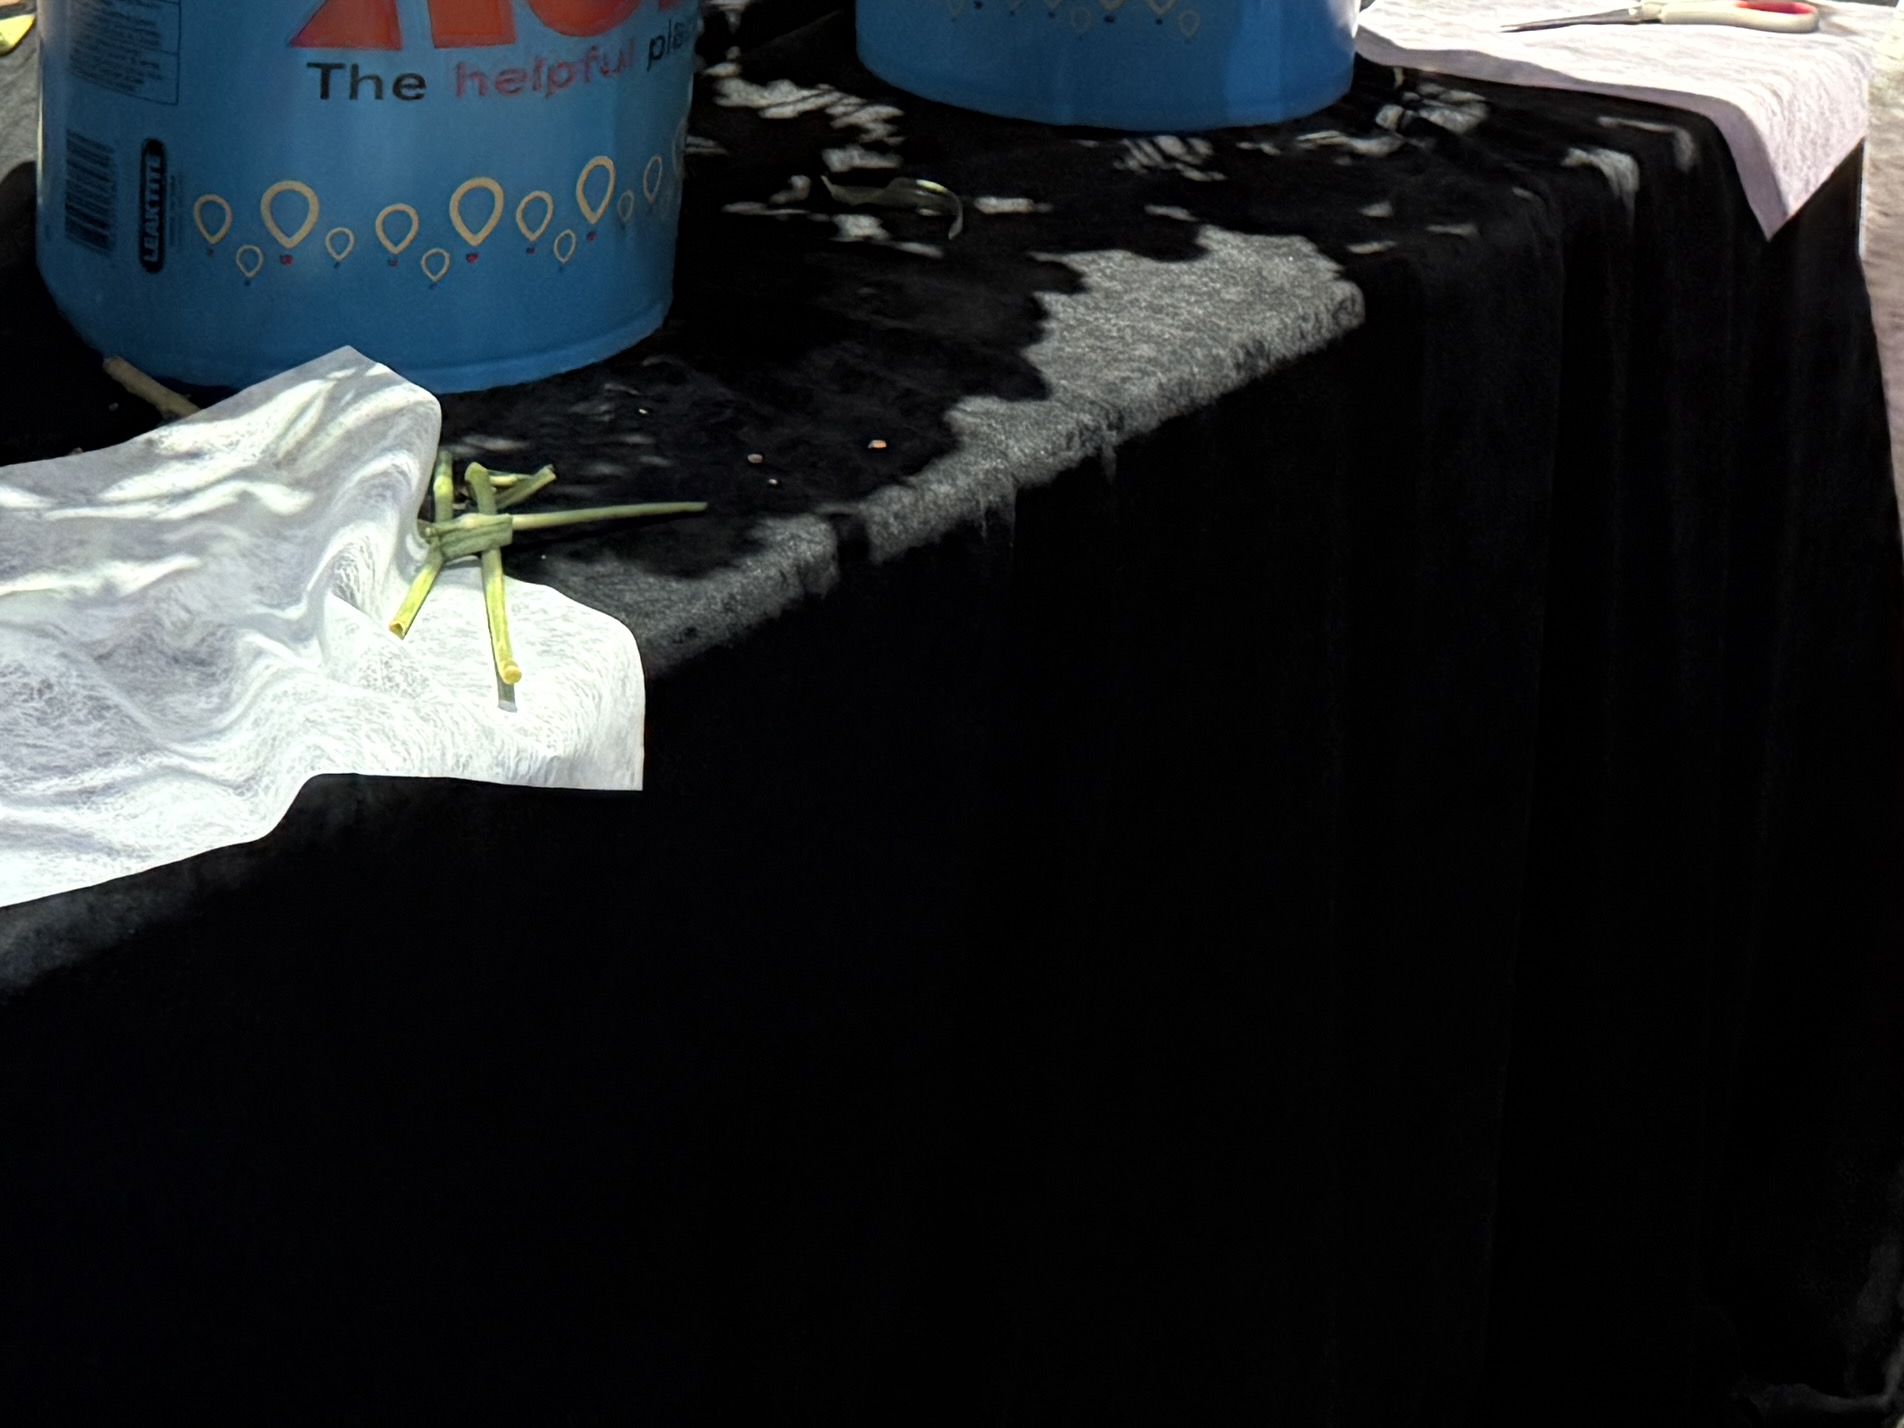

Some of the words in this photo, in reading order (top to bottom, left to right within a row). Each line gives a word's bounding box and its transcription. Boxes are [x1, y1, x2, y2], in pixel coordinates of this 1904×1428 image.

[307, 61, 427, 101] The
[453, 37, 634, 98] helpful
[646, 12, 693, 72] pla
